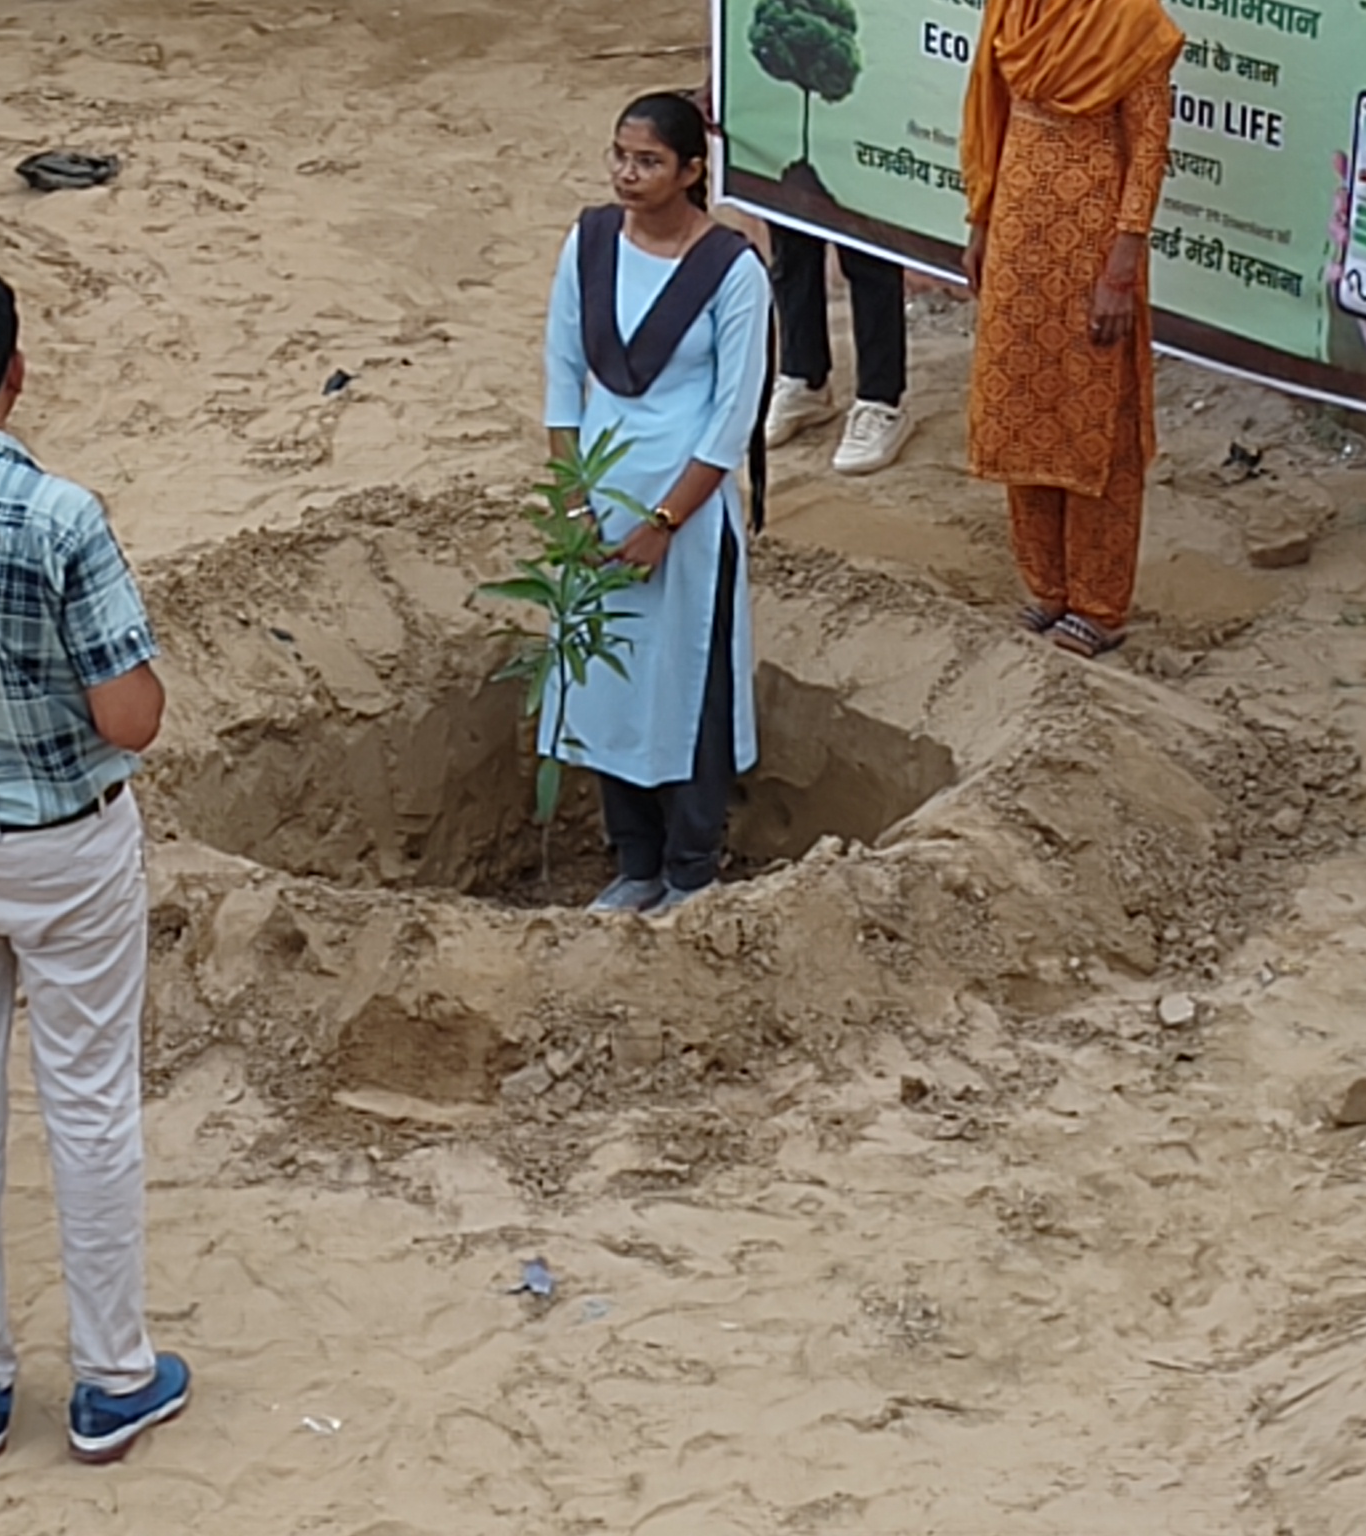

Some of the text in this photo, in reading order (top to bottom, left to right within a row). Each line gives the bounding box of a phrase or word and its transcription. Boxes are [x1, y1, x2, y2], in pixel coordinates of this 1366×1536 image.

[924, 21, 970, 64] Eco
[1223, 100, 1283, 148] LIFE
[854, 140, 932, 185] राजकीय
[1184, 234, 1225, 272] मंडी
